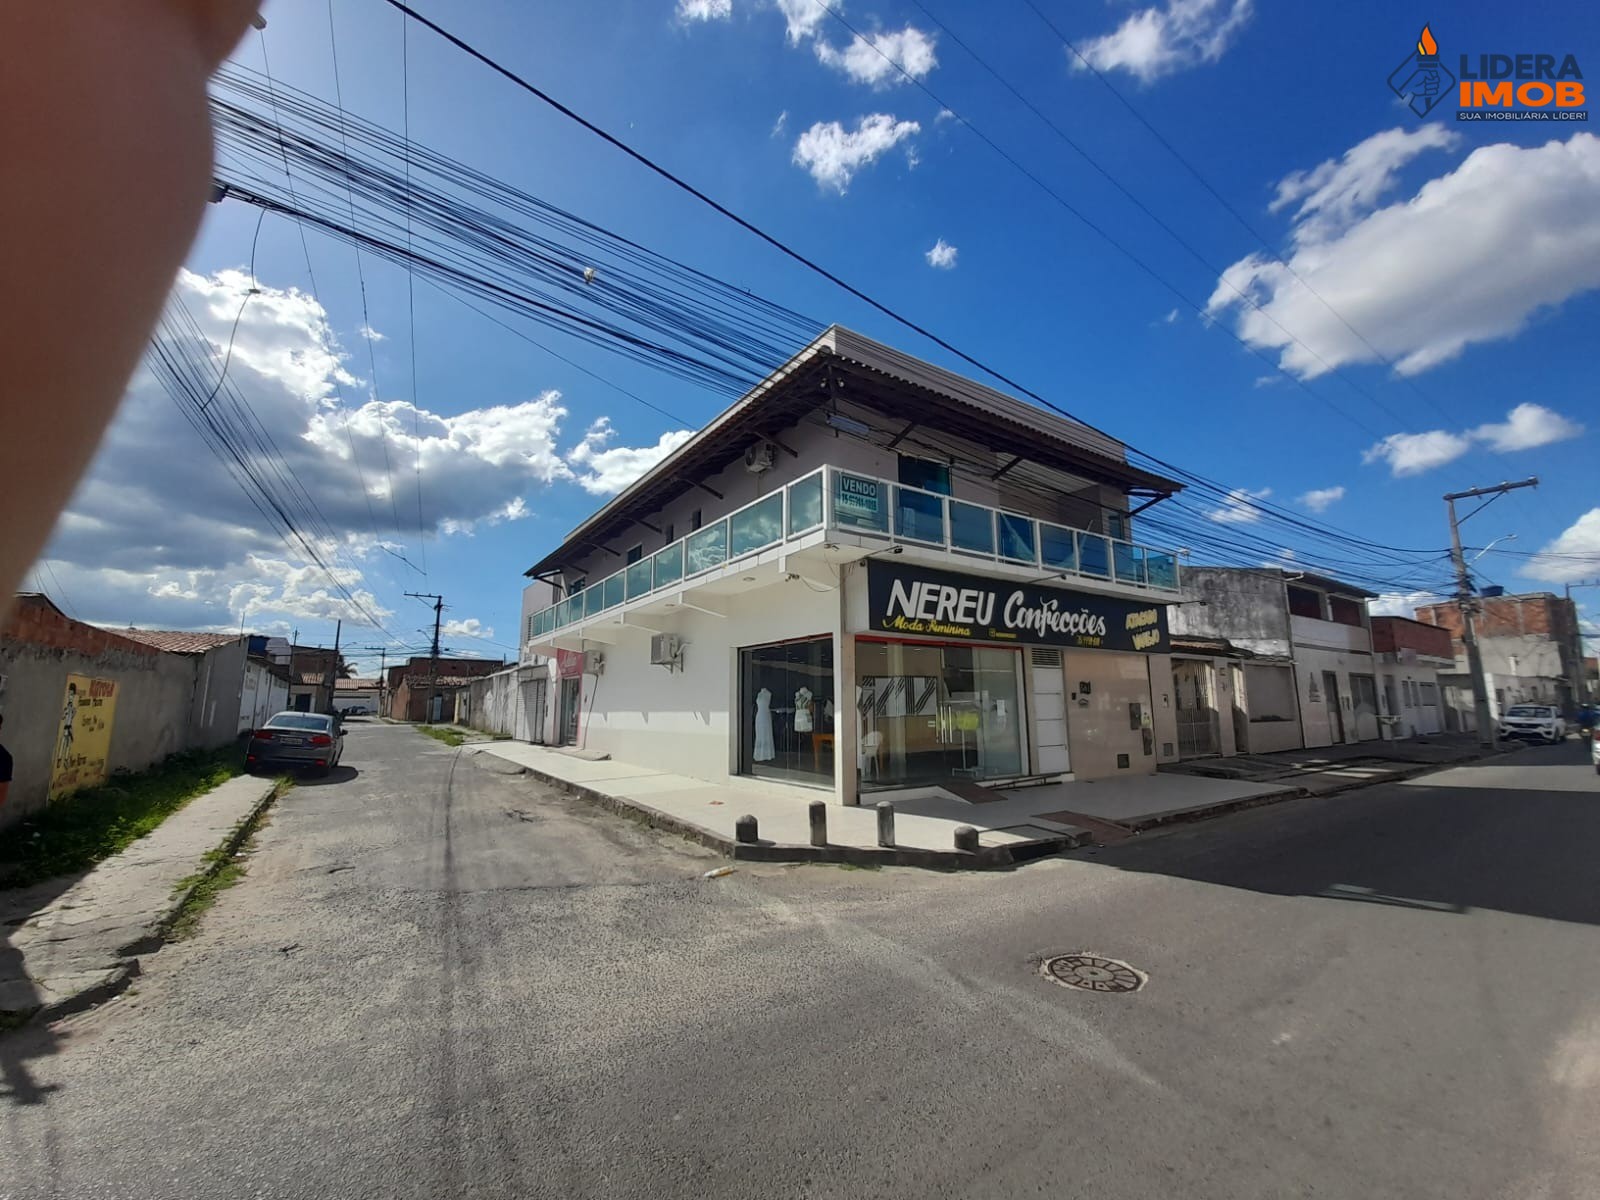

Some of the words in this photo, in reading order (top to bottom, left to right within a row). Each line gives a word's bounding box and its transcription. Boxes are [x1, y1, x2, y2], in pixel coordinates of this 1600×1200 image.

[842, 477, 876, 497] VENDO
[886, 578, 996, 626] NEREU
[1003, 590, 1106, 638] Confecções
[882, 615, 923, 632] Moda
[925, 619, 971, 637] Feminina
